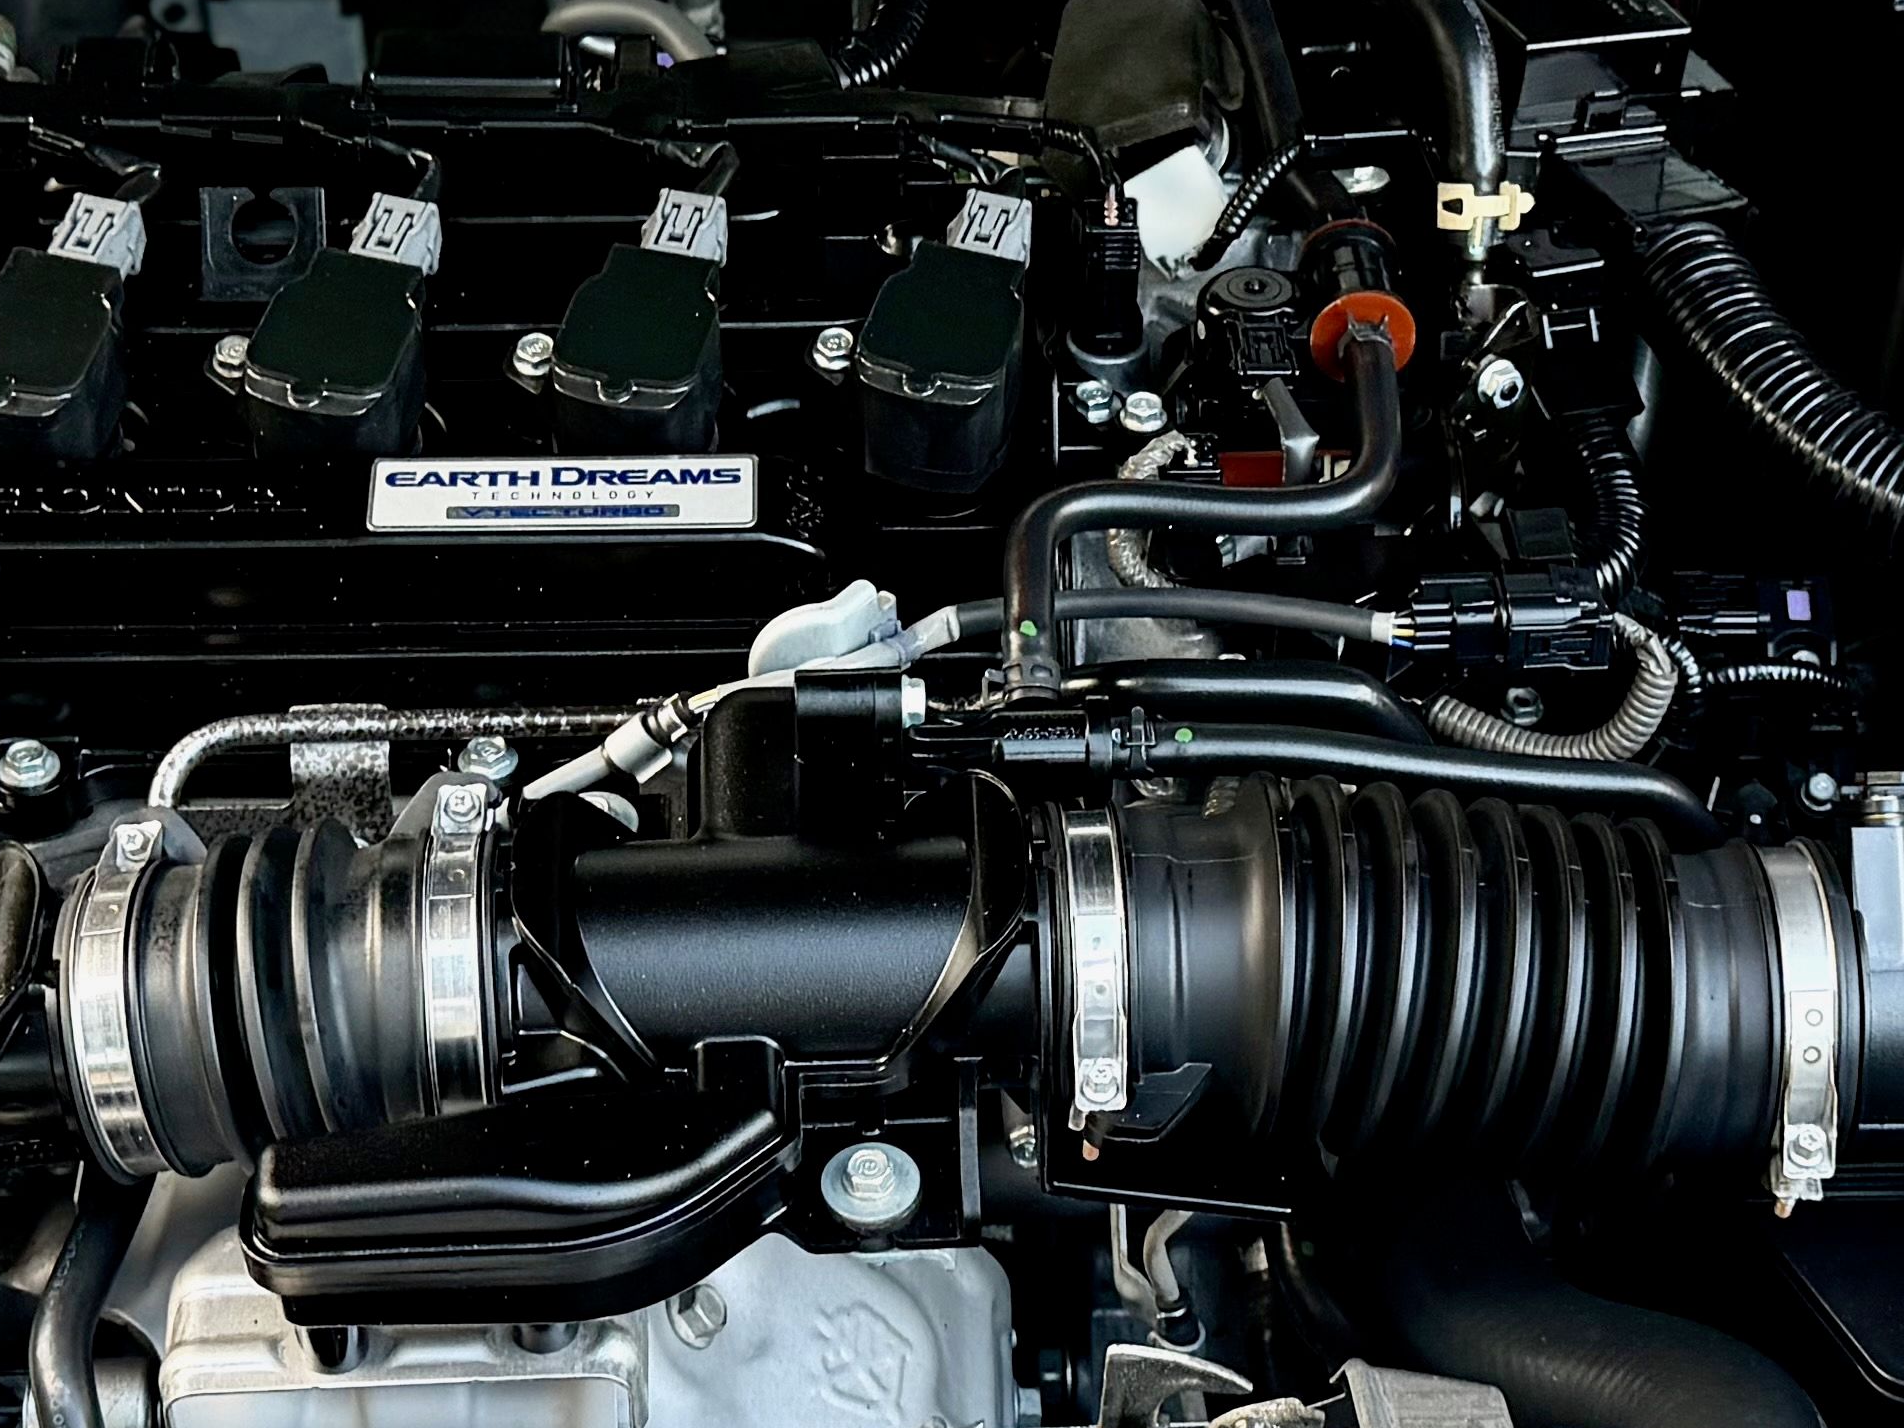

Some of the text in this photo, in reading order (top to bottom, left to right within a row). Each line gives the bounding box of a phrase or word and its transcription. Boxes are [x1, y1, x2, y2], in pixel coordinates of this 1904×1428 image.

[384, 466, 742, 488] EARTH DREAMS
[472, 489, 656, 501] TECHNOLOGY
